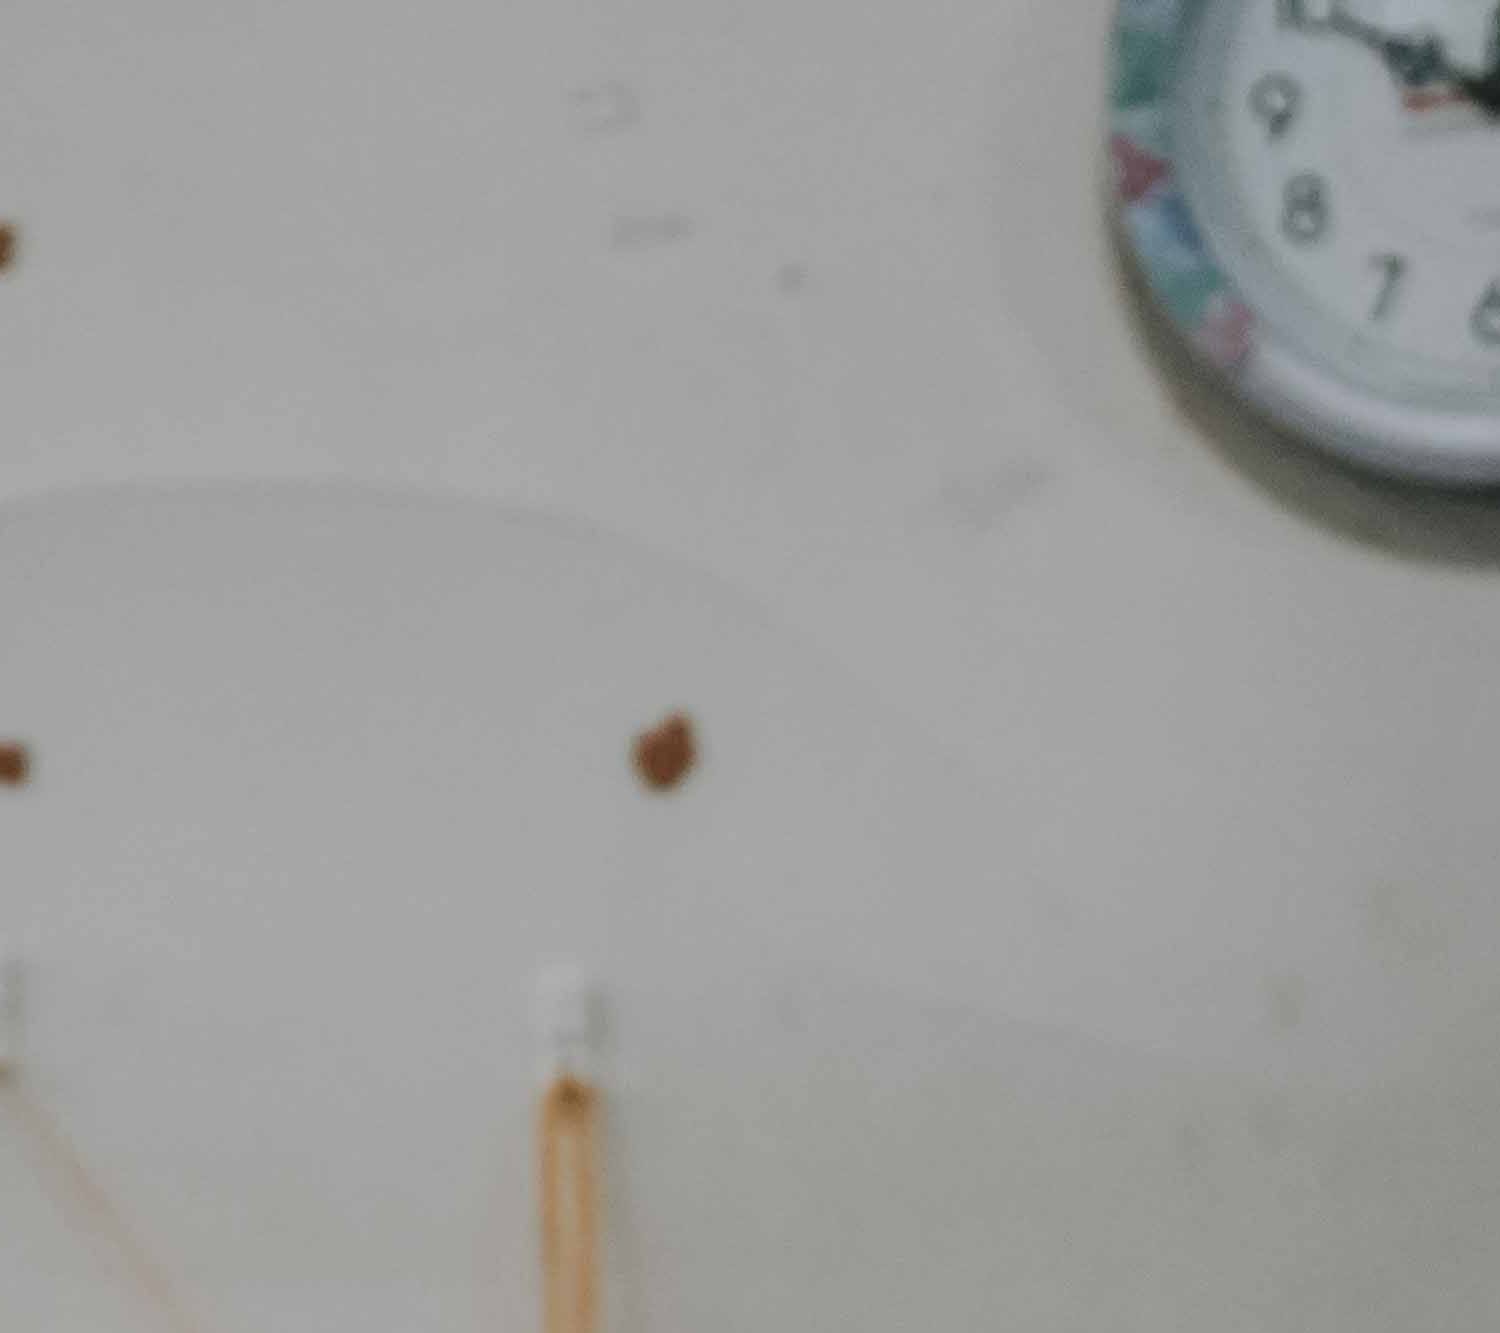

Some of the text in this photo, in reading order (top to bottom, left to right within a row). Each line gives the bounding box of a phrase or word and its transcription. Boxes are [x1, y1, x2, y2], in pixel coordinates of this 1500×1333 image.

[1250, 70, 1302, 140] 9
[1280, 173, 1330, 244] 8
[1366, 253, 1406, 322] 7
